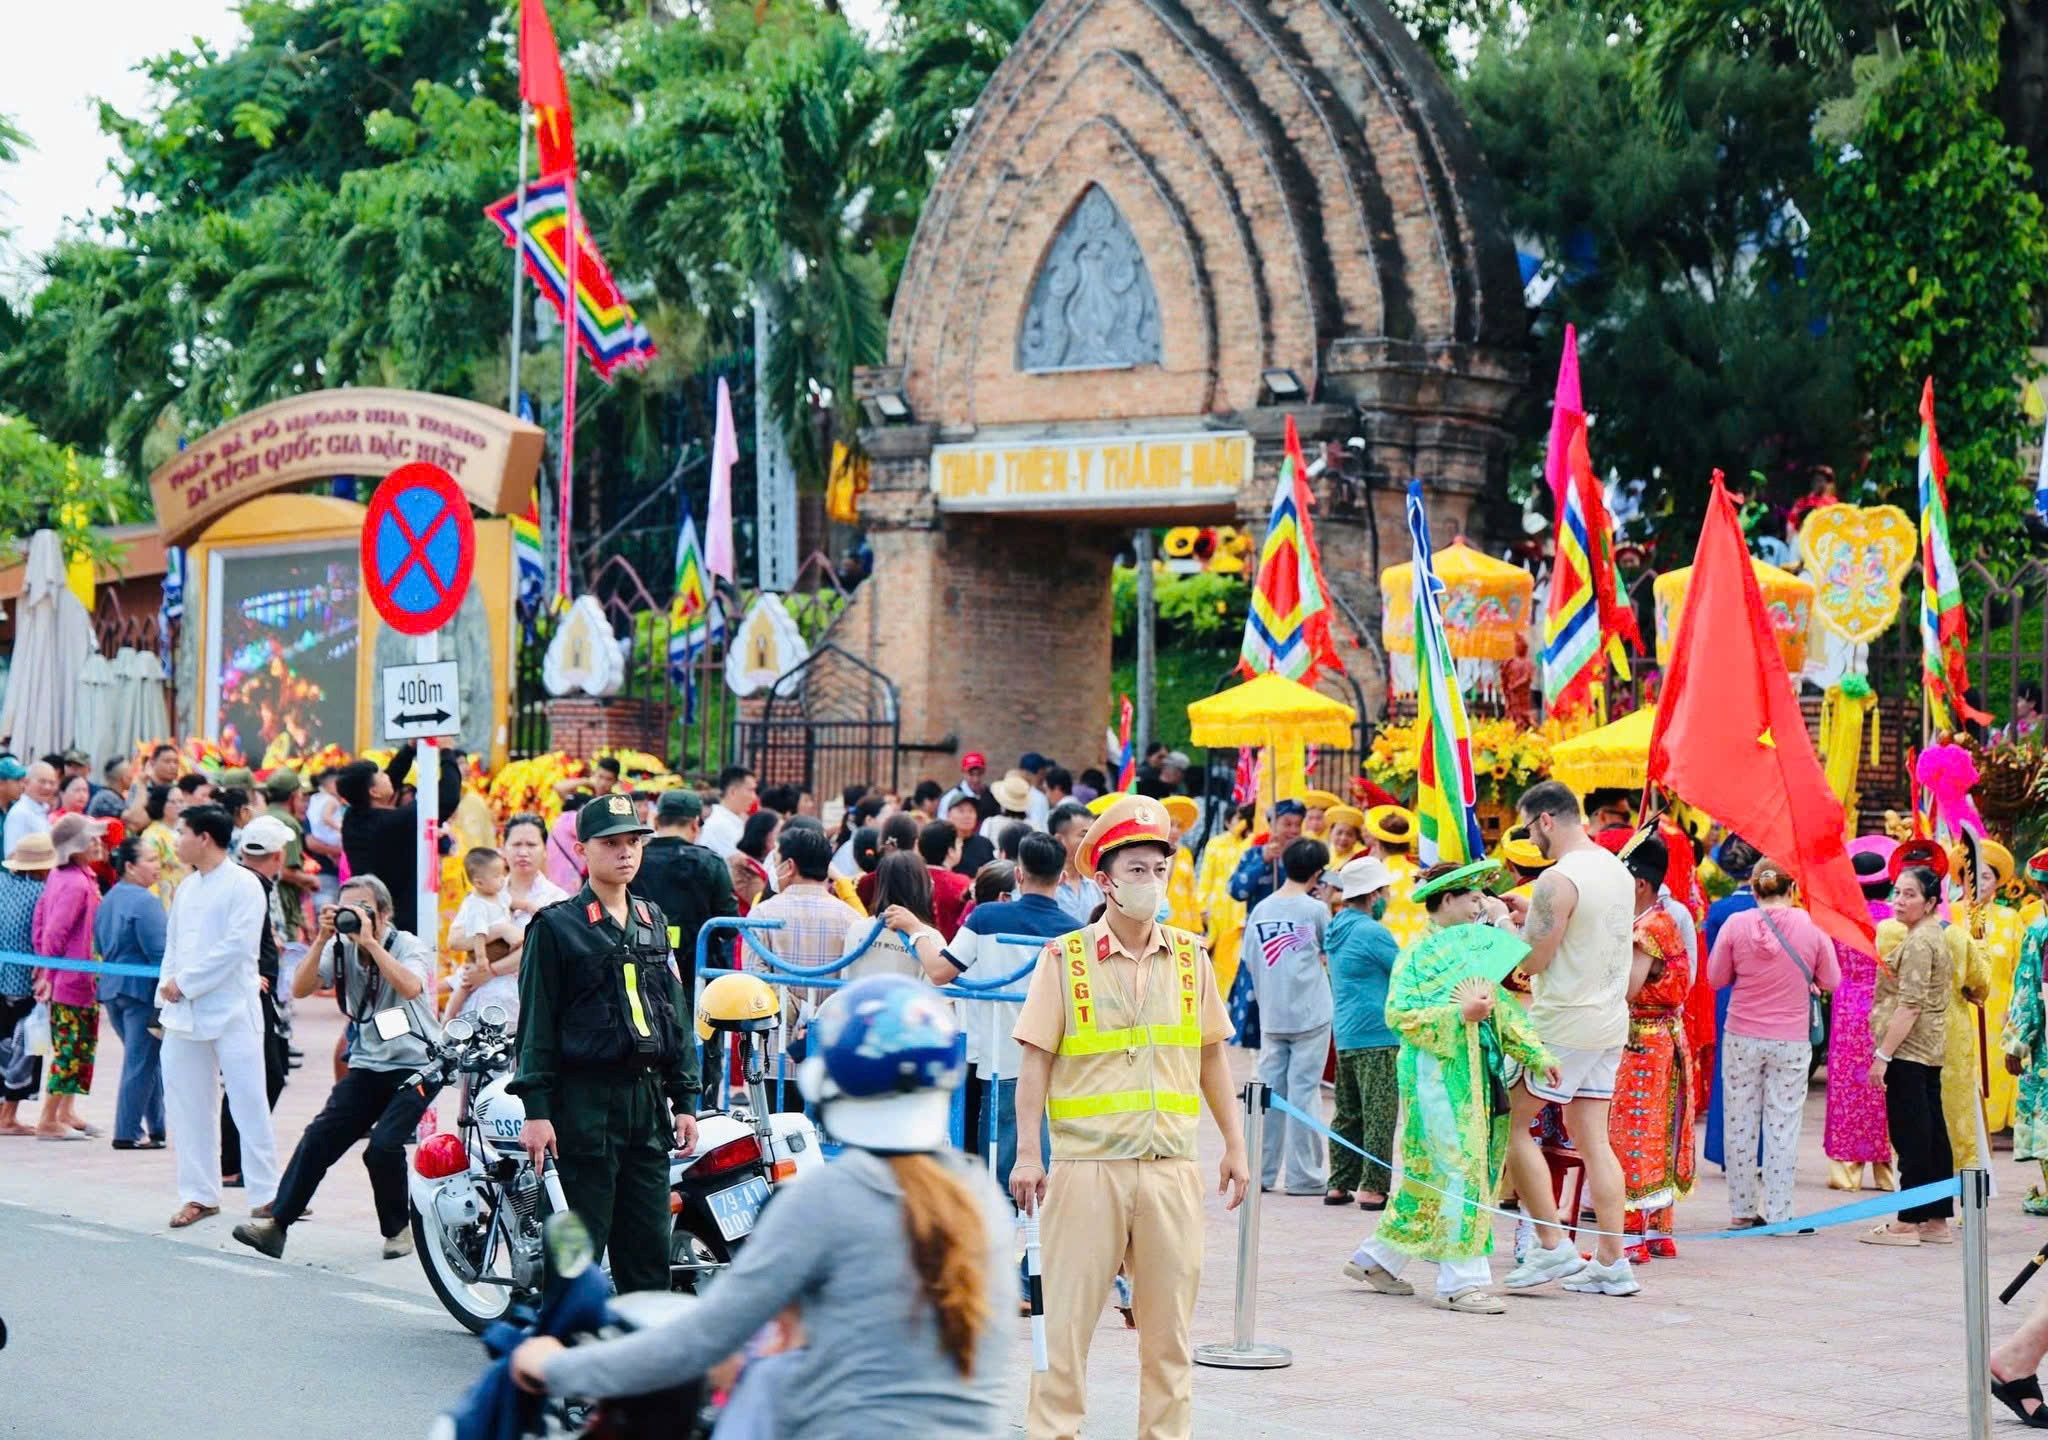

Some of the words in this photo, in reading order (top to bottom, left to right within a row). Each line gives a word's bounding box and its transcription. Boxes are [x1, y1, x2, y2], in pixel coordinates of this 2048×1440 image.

[364, 408, 410, 427] NHA
[416, 415, 487, 449] TRANG
[187, 479, 208, 509] DI
[210, 456, 260, 493] TÍCH
[264, 431, 322, 471] QUỐC
[327, 434, 362, 455] GIA
[368, 430, 412, 460] ĐẶC
[398, 679, 443, 705] 400m
[1067, 939, 1090, 1023] CSGT
[495, 1119, 522, 1137] CSG
[717, 1183, 762, 1215] 79-A1
